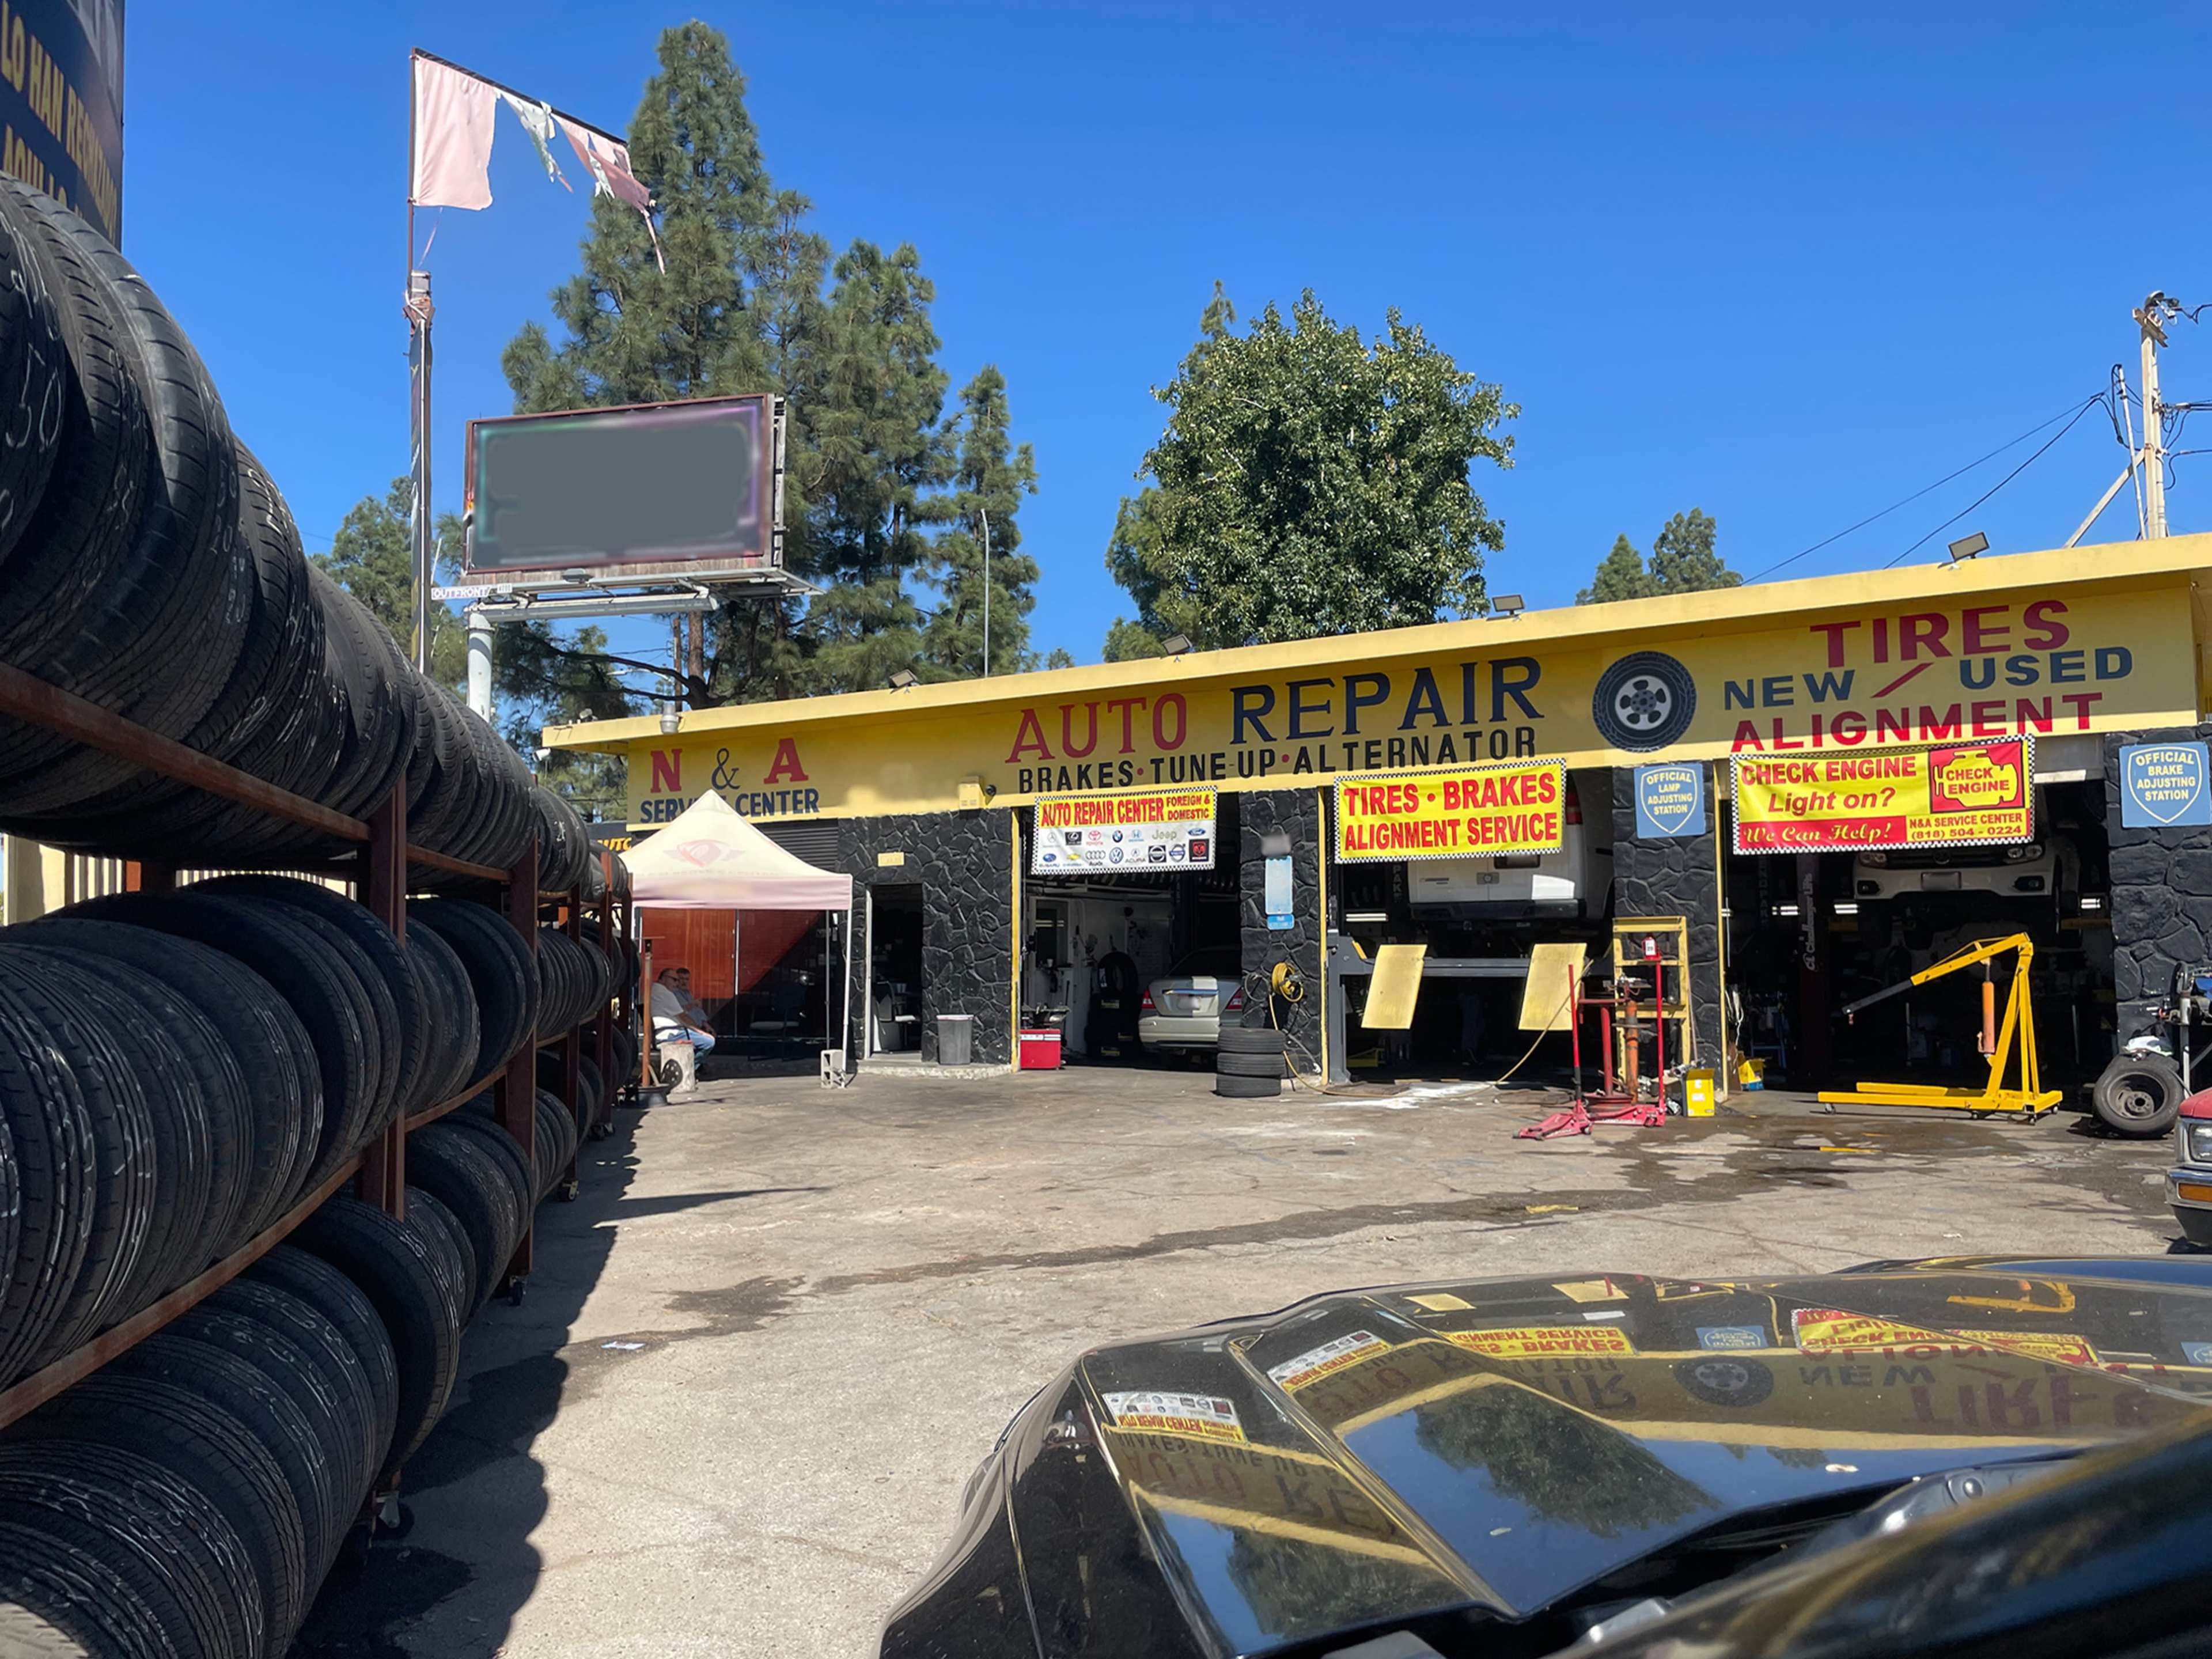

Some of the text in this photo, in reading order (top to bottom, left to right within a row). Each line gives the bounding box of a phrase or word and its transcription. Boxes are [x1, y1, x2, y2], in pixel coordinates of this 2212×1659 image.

[1810, 600, 2070, 668] TIRES
[1724, 670, 1855, 710] NEW
[1960, 646, 2133, 690] USED
[1005, 657, 1545, 764] AUTO REPAIR
[1730, 692, 2103, 752] ALIGNMENT
[650, 738, 809, 794] N & A
[1018, 760, 1134, 794] BRAKES
[1293, 727, 1535, 774] ALTERNATOR
[2135, 751, 2194, 766] OFFICIAL
[1646, 771, 1692, 785] OFFICIAL
[1741, 756, 1917, 786] CHECK ENGINE
[1945, 767, 1993, 782] CHECK
[2147, 765, 2183, 776] BRAKE
[1658, 783, 1681, 793] LAMP
[1948, 780, 2010, 795] ENGINE
[2137, 777, 2196, 789] ADJUSTING
[1344, 772, 1556, 816] TIRES BRAKES
[1647, 793, 1692, 805] ADJUSTING
[1768, 786, 1896, 817] Light on?
[2145, 789, 2189, 801] STATION
[735, 788, 819, 817] CENTER
[1041, 794, 1210, 827] AUTO REPAIR CENTER FOREIGN &
[1653, 804, 1688, 815] STATION
[1168, 808, 1209, 821] DOMESTIC
[1910, 813, 2022, 829] N&A SERVICE CENTER
[1152, 830, 1177, 841] Jeep
[1344, 812, 1558, 851] ALIGNMENT SERVICE
[1743, 822, 1891, 843] We Can Help!
[1911, 828, 1945, 840] (818)
[1950, 827, 1975, 838] 504
[1987, 825, 2022, 836] 0224
